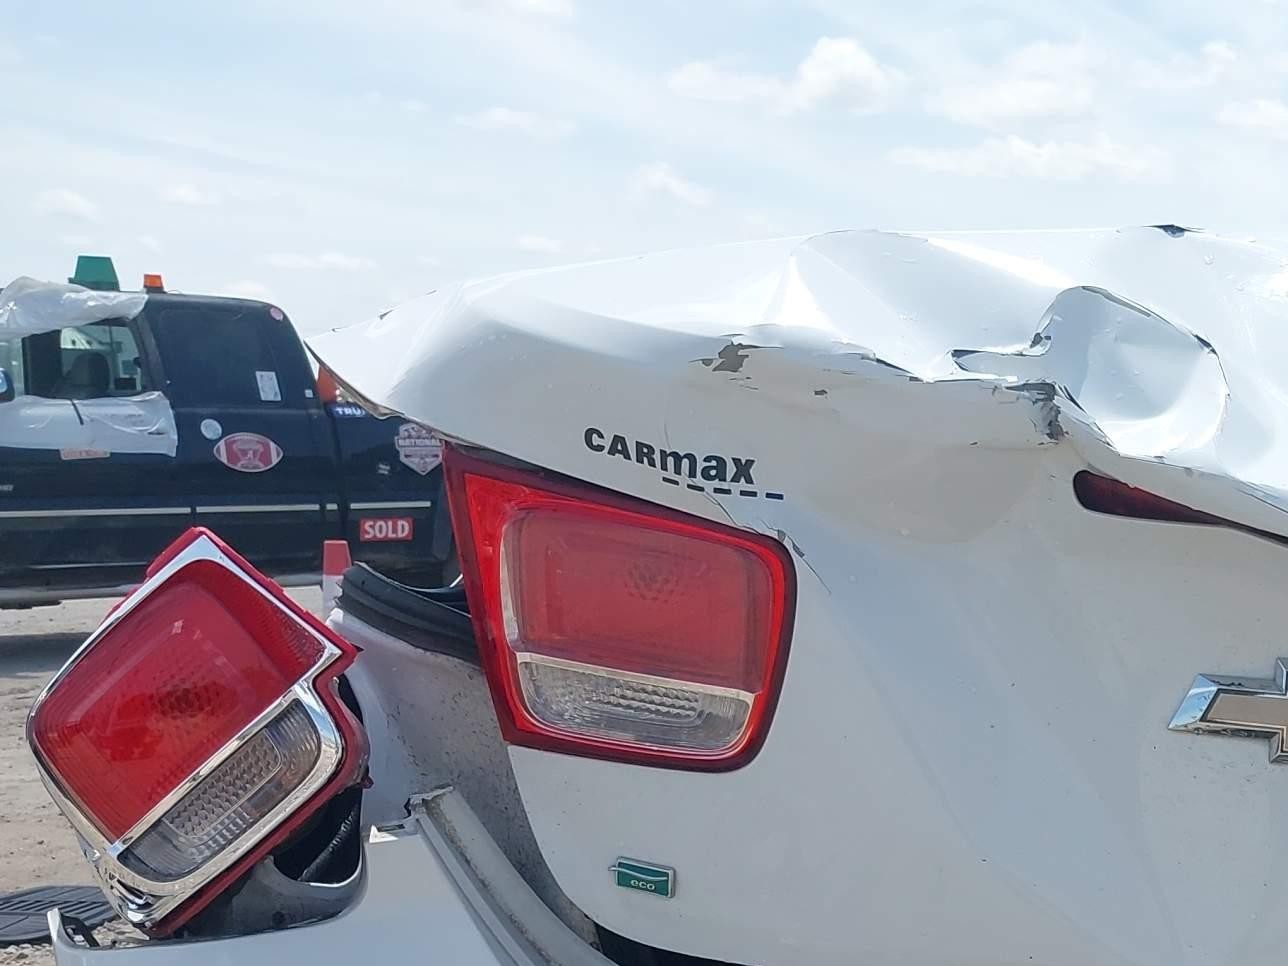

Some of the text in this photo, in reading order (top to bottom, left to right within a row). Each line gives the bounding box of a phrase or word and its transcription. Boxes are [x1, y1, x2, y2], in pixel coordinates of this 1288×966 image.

[335, 406, 366, 416] TRU
[364, 520, 410, 538] SOLD
[630, 879, 656, 891] eco
